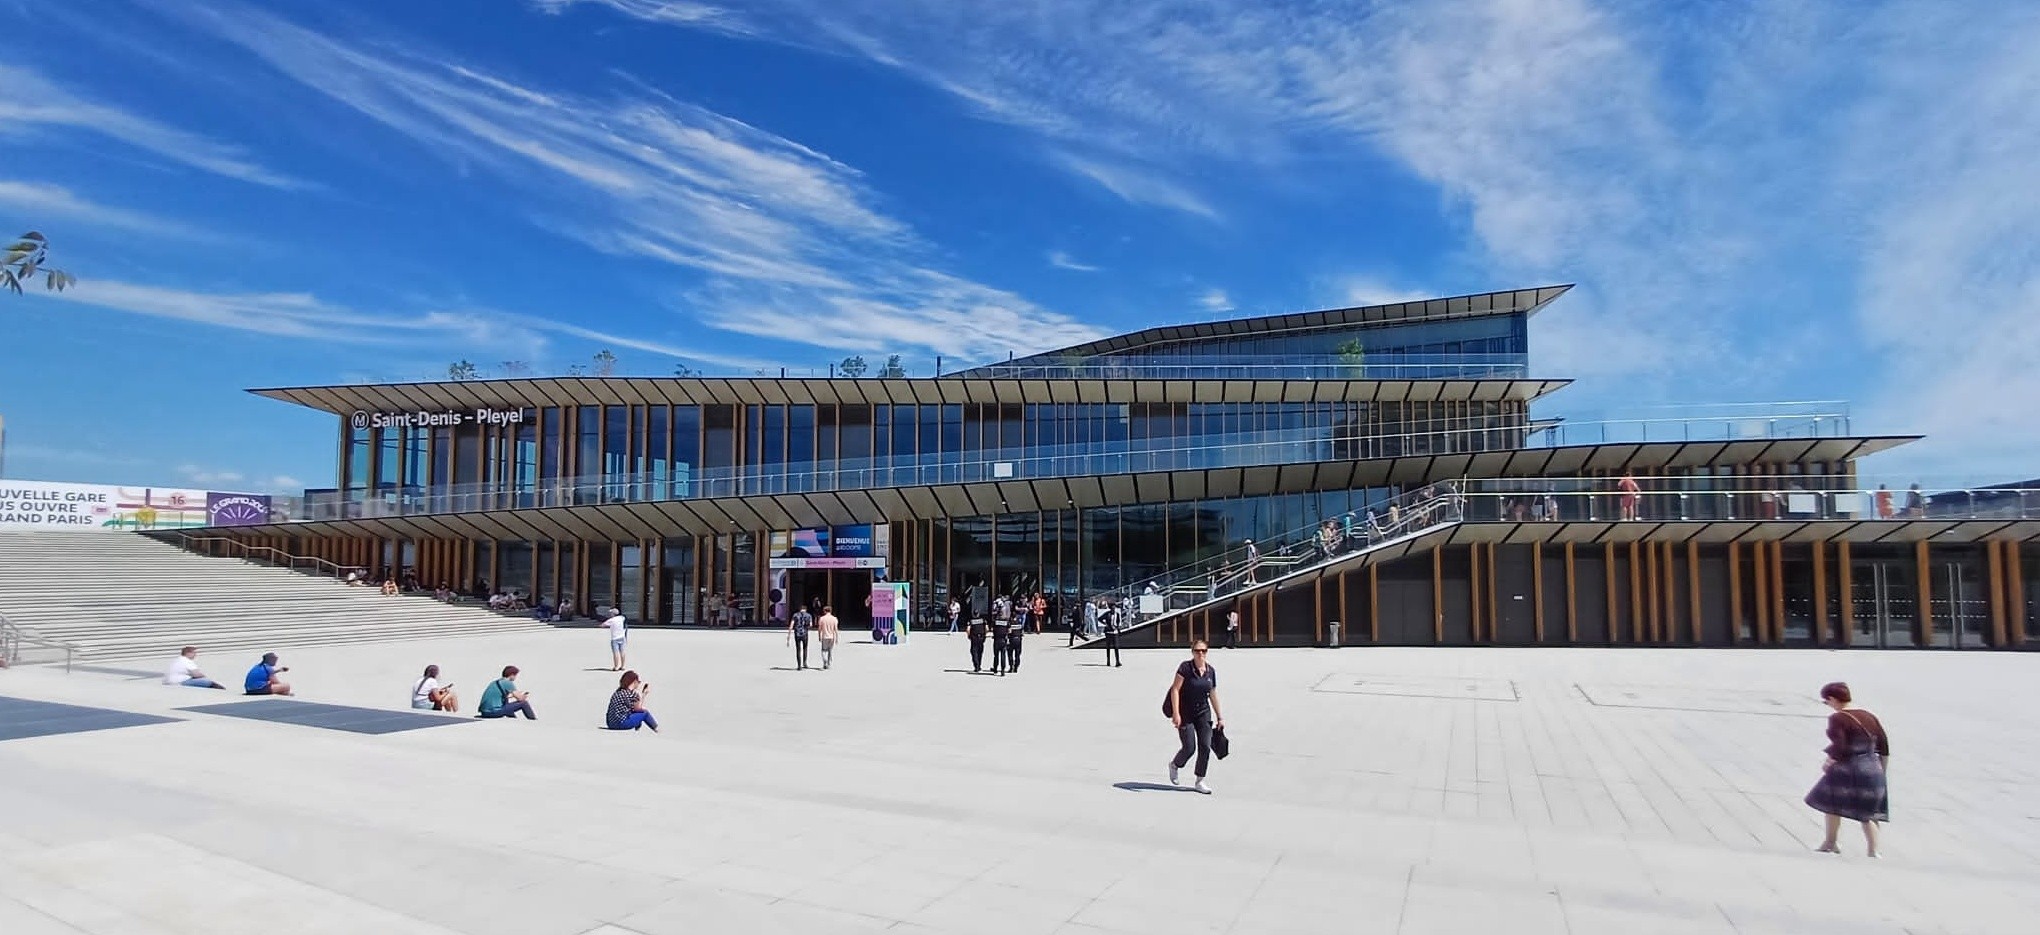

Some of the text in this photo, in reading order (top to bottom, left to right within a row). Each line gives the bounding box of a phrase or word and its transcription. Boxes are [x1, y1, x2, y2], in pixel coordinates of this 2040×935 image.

[372, 411, 462, 428] Saint-Denis
[476, 407, 523, 427] Pleyel
[65, 492, 107, 502] GARE
[171, 496, 185, 505] 16
[20, 501, 78, 513] OUVRE
[48, 514, 93, 525] PARIS
